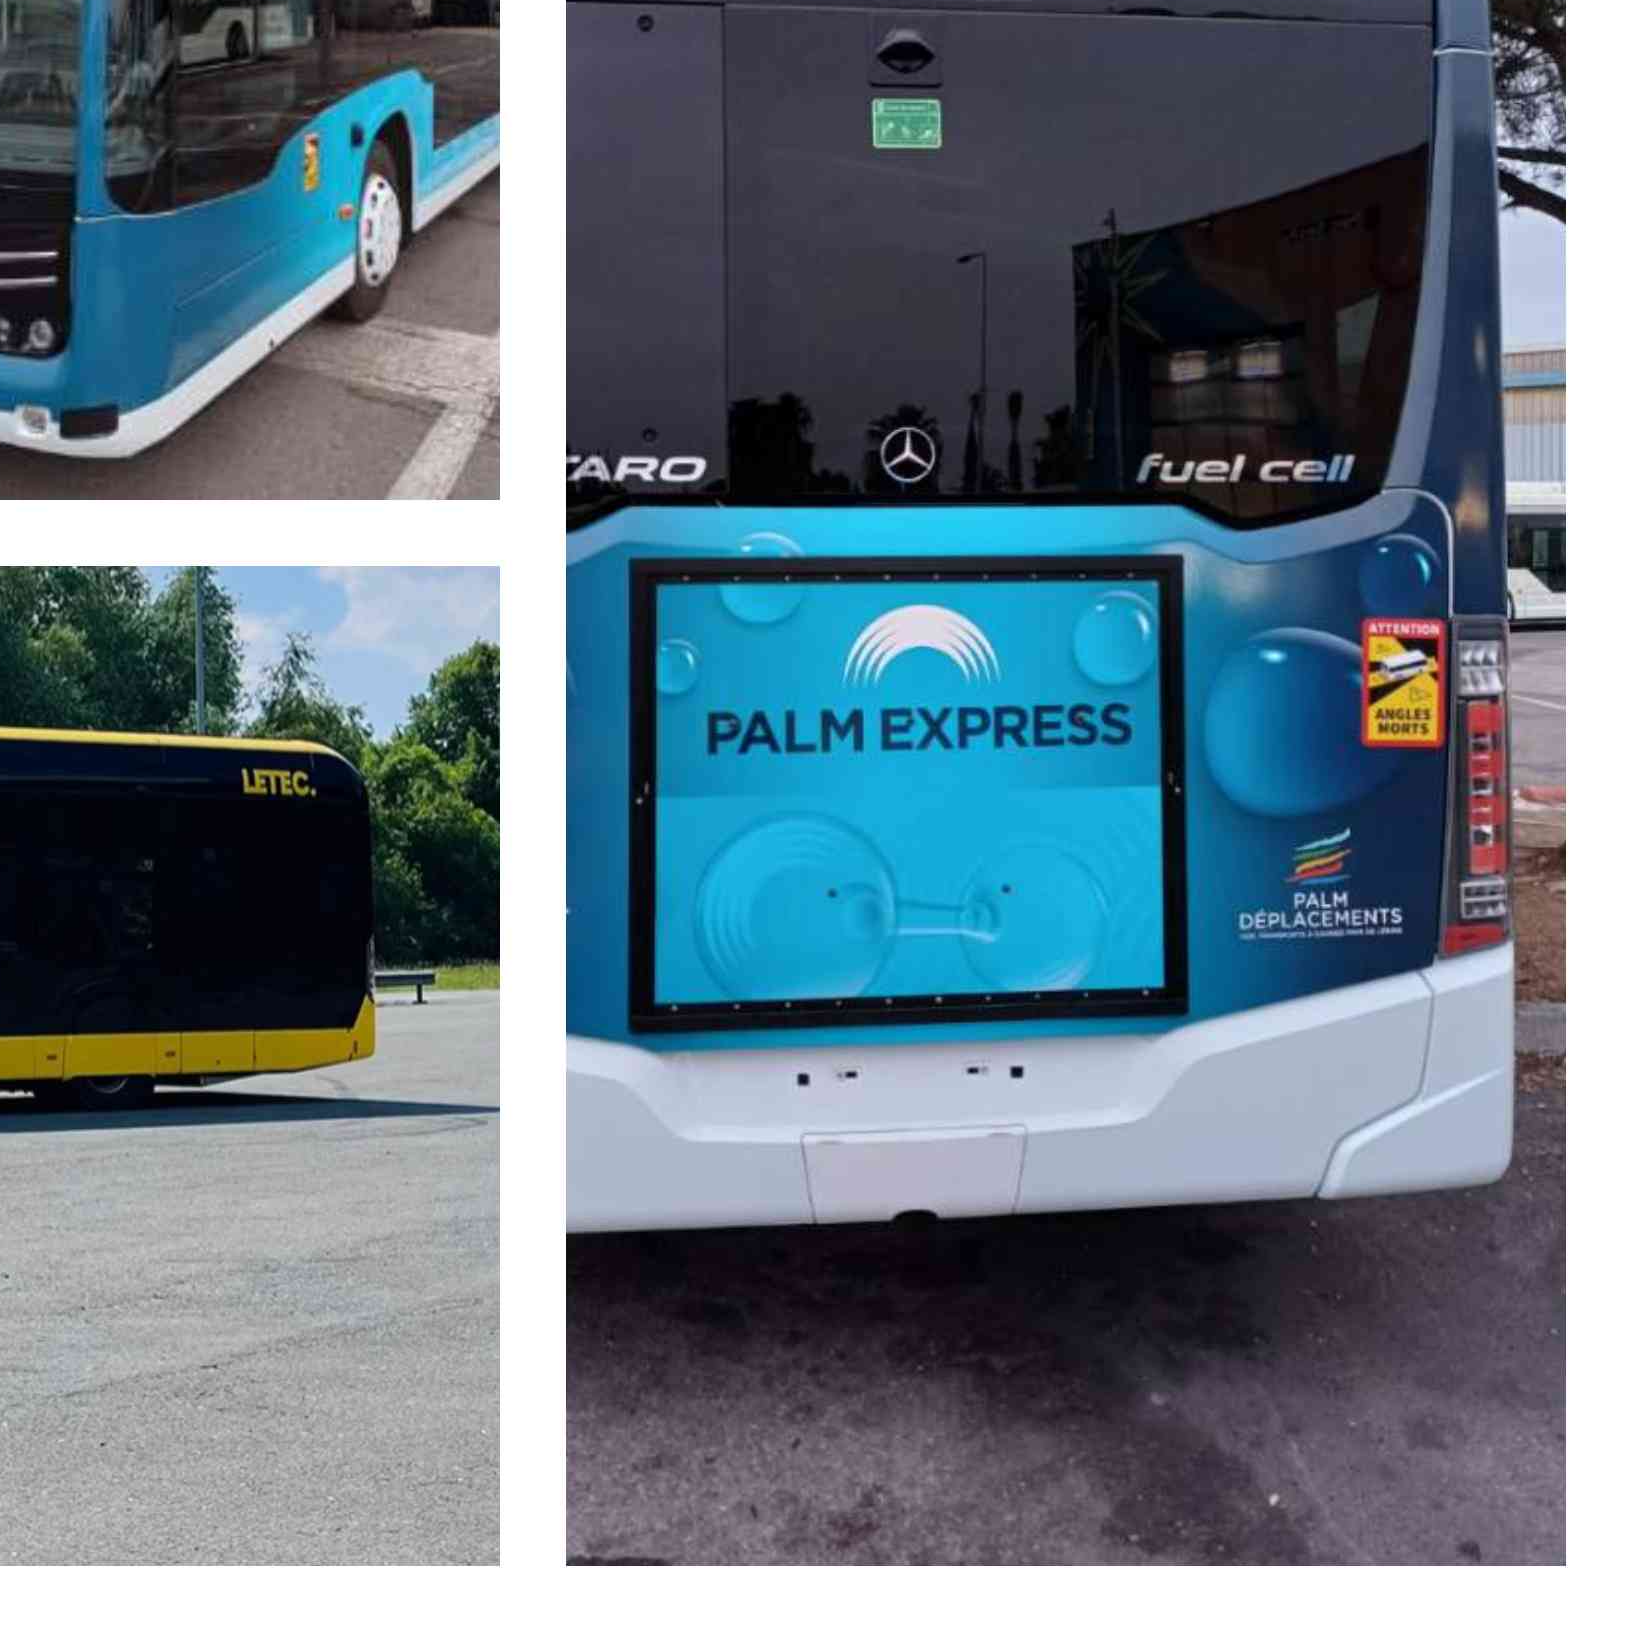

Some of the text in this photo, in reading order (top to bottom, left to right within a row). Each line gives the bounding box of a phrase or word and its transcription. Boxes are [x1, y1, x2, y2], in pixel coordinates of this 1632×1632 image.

[1135, 452, 1356, 483] fuel cell
[1370, 623, 1440, 636] ATTENTION
[1375, 708, 1430, 721] ANGLES
[706, 702, 1134, 756] PALM EXPRESS
[1377, 721, 1430, 735] MORTS
[241, 768, 317, 797] LETEC.
[1293, 891, 1349, 910] PALM
[1239, 907, 1403, 931] DÉPLACEMENTS
